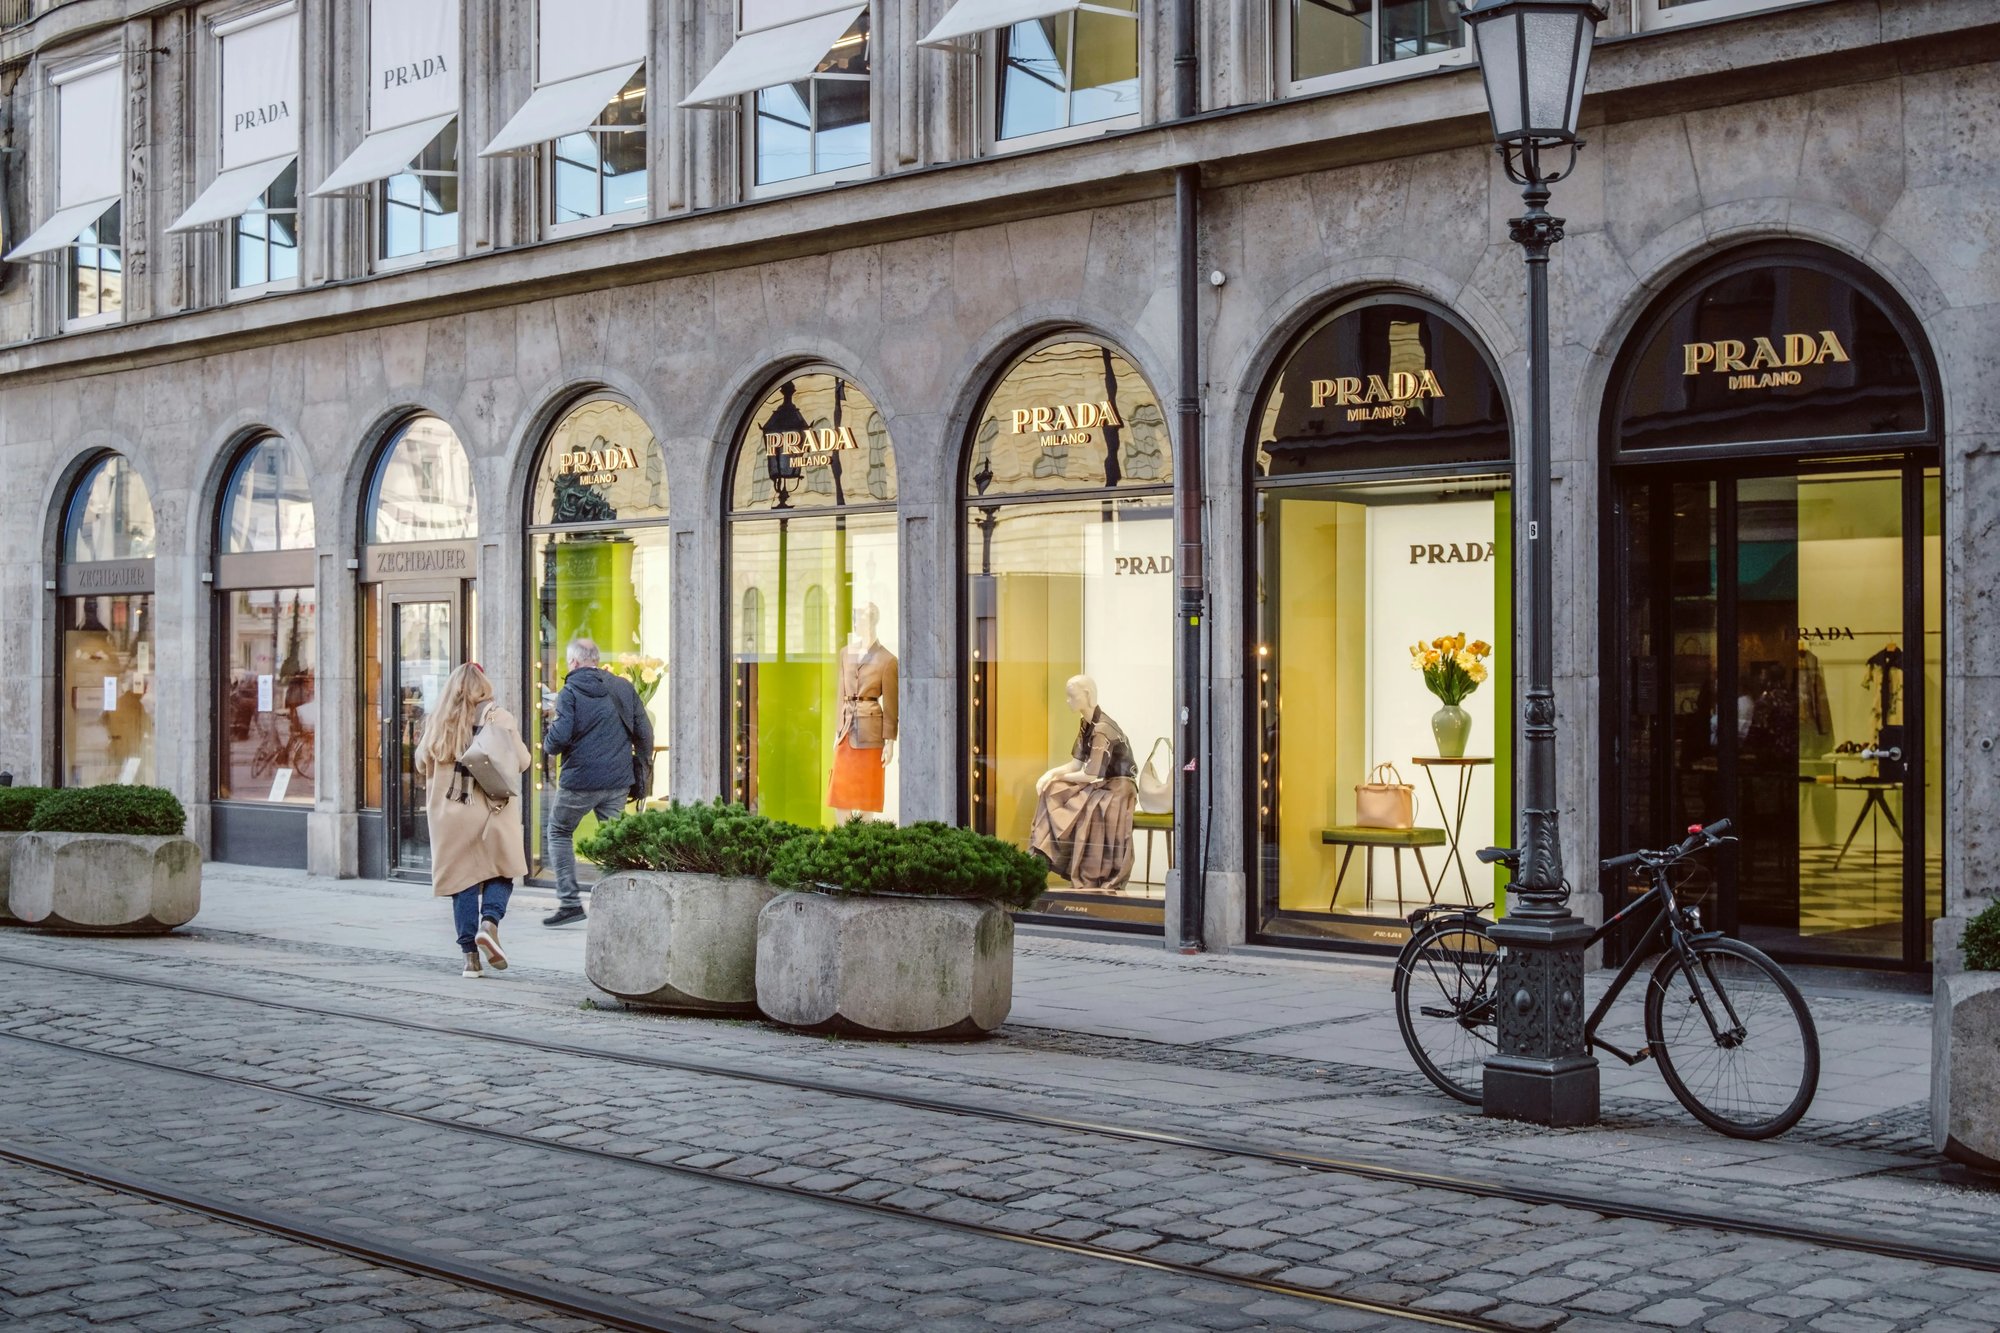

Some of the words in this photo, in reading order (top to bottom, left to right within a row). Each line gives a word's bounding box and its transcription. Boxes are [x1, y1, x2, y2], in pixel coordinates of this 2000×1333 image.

[383, 55, 447, 90] PRADA
[234, 100, 290, 132] PRADA
[1682, 330, 1850, 376] PRADA
[1310, 369, 1445, 409] PRADA
[1728, 370, 1802, 390] MILANO
[1011, 400, 1122, 435] PRADA
[1347, 405, 1406, 422] MILANO
[765, 426, 859, 456] PRADA
[1040, 432, 1091, 447] MILANO
[559, 447, 639, 475] PRADA
[789, 455, 833, 468] MILANO
[580, 473, 617, 486] MILANO
[1530, 524, 1536, 537] 6
[376, 548, 466, 573] ZECHBAUER
[1114, 555, 1174, 575] PRAD
[79, 567, 145, 588] ZECHBAUER
[1784, 626, 1855, 641] RADA
